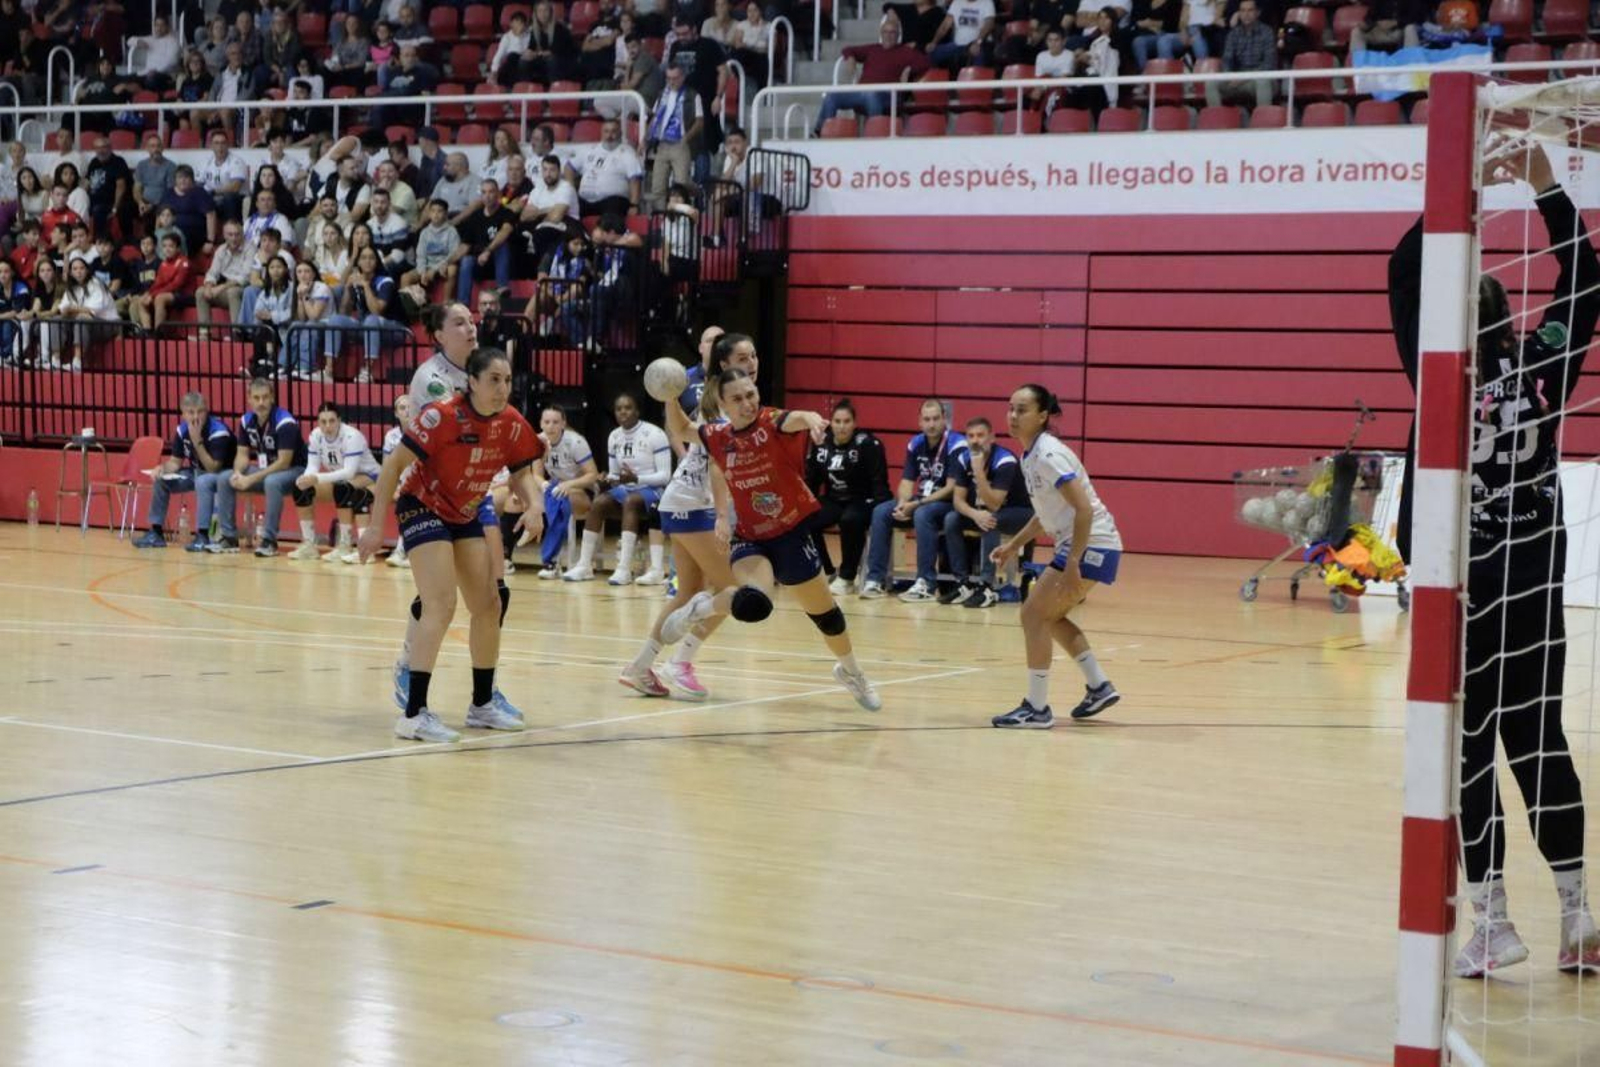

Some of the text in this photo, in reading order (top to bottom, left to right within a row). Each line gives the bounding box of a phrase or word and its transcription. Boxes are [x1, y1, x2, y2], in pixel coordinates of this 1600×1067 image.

[810, 167, 842, 189] 30
[850, 161, 911, 189] años
[919, 162, 1037, 193] después,
[1046, 163, 1079, 186] ha
[1088, 160, 1194, 190] llegado
[1205, 160, 1229, 184] la
[1239, 159, 1305, 184] hora
[752, 427, 768, 446] 10
